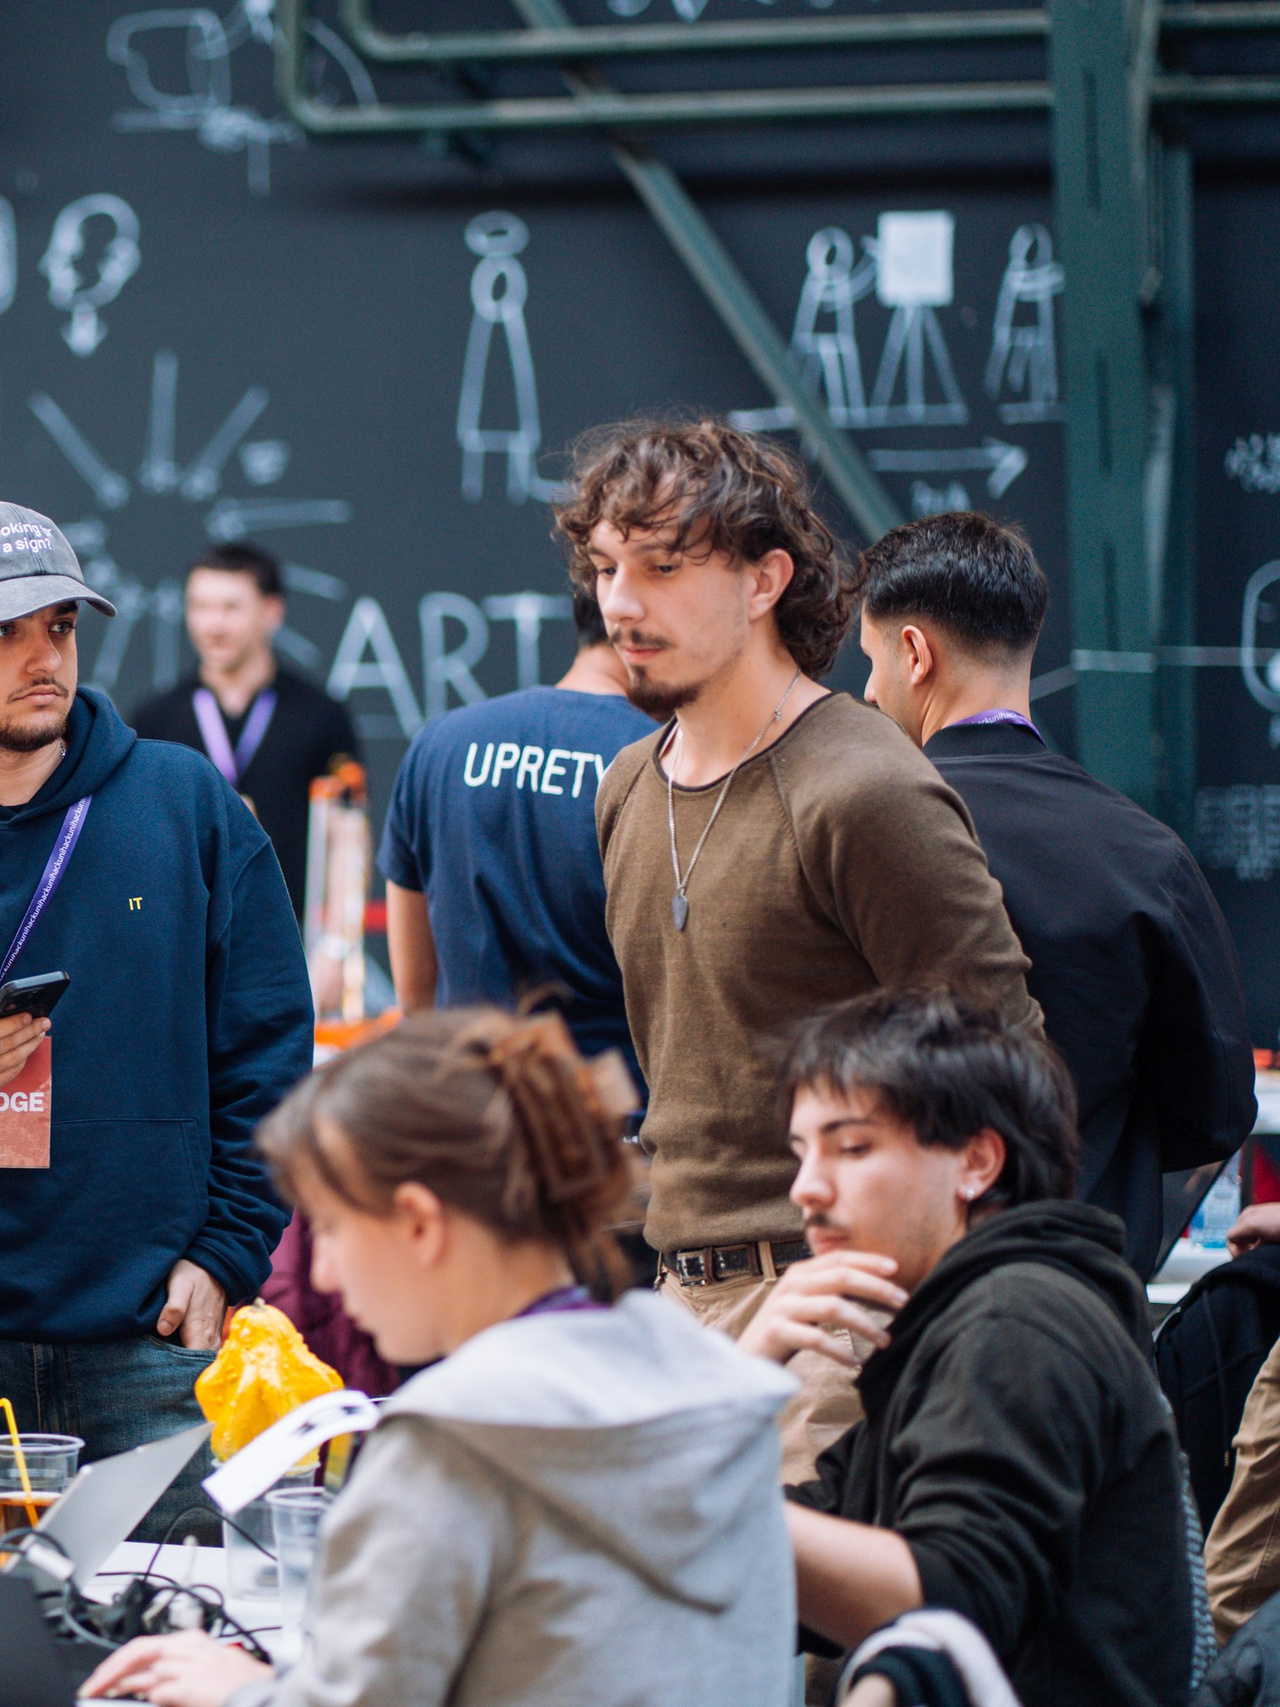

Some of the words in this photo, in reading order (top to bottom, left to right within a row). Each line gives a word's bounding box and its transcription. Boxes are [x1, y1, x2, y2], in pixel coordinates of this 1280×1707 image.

[2, 542, 13, 553] a
[15, 537, 53, 553] sign?
[326, 592, 575, 740] ART
[128, 896, 143, 911] IT
